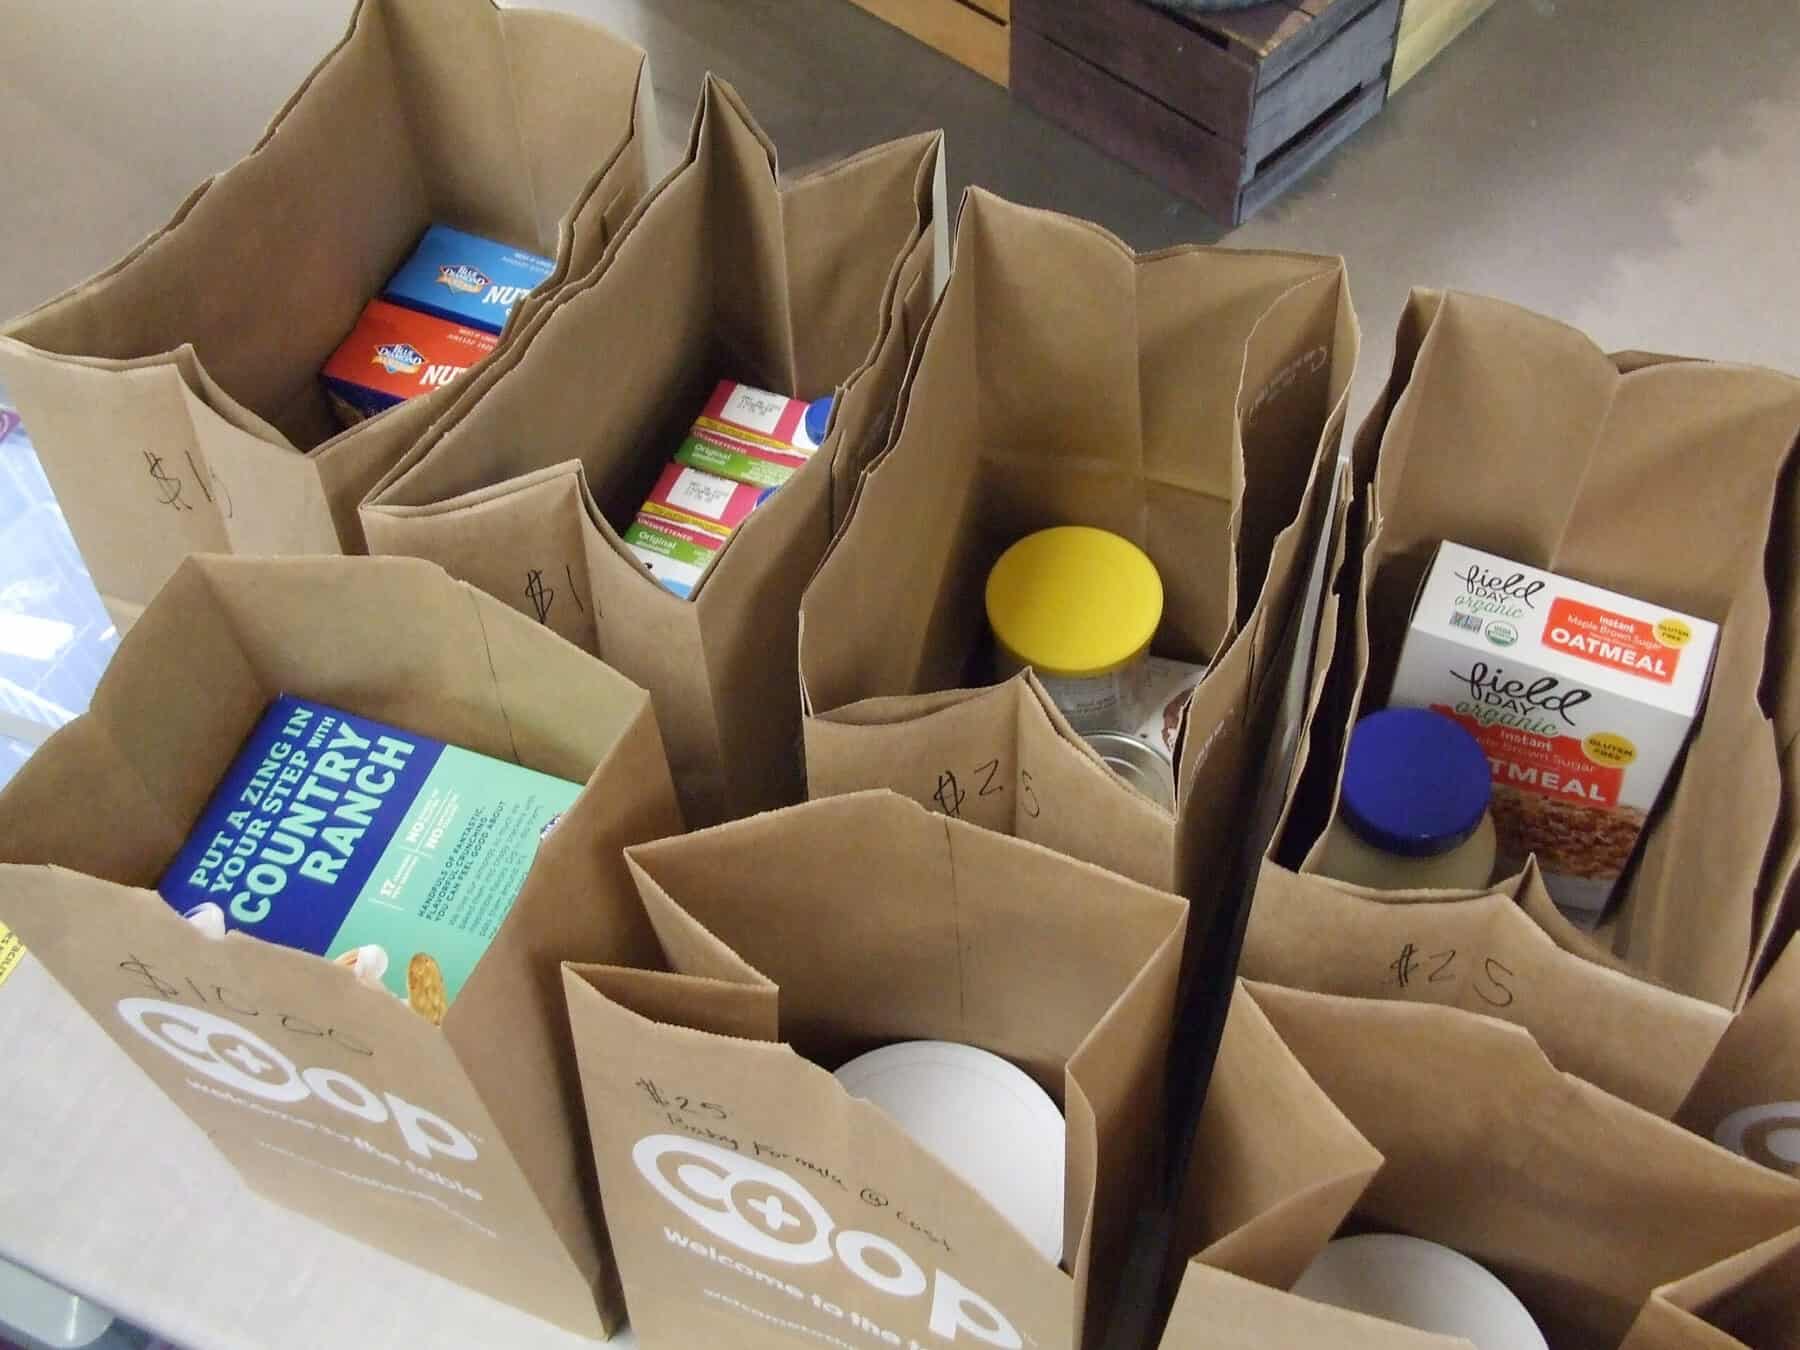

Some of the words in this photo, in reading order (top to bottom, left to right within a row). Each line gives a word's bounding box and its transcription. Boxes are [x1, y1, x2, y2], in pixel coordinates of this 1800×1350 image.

[638, 531, 677, 550] Original
[1454, 564, 1545, 609] field
[1475, 587, 1509, 604] DAY
[1567, 614, 1598, 632] Maple
[1600, 625, 1632, 642] Brown
[1599, 615, 1634, 633] Instant
[1551, 627, 1666, 677] OATMEAL
[1449, 662, 1593, 727] field
[1484, 692, 1536, 716] DAY
[1501, 730, 1551, 751] Instant
[188, 831, 234, 888] PUT
[226, 809, 250, 830] A
[240, 741, 292, 806] ZING
[282, 706, 314, 738] IN
[1487, 756, 1607, 802] TMEAL
[209, 818, 273, 894] YOUR
[262, 750, 310, 815] STEP
[307, 715, 337, 749] WITH
[230, 722, 371, 924] COUNTRY
[300, 735, 416, 885] RANCH
[434, 903, 449, 923] YOU
[445, 881, 461, 902] CAN
[470, 830, 489, 857] GOOD
[1390, 943, 1513, 1007] $25
[811, 1293, 844, 1319] to
[850, 1311, 901, 1346] the
